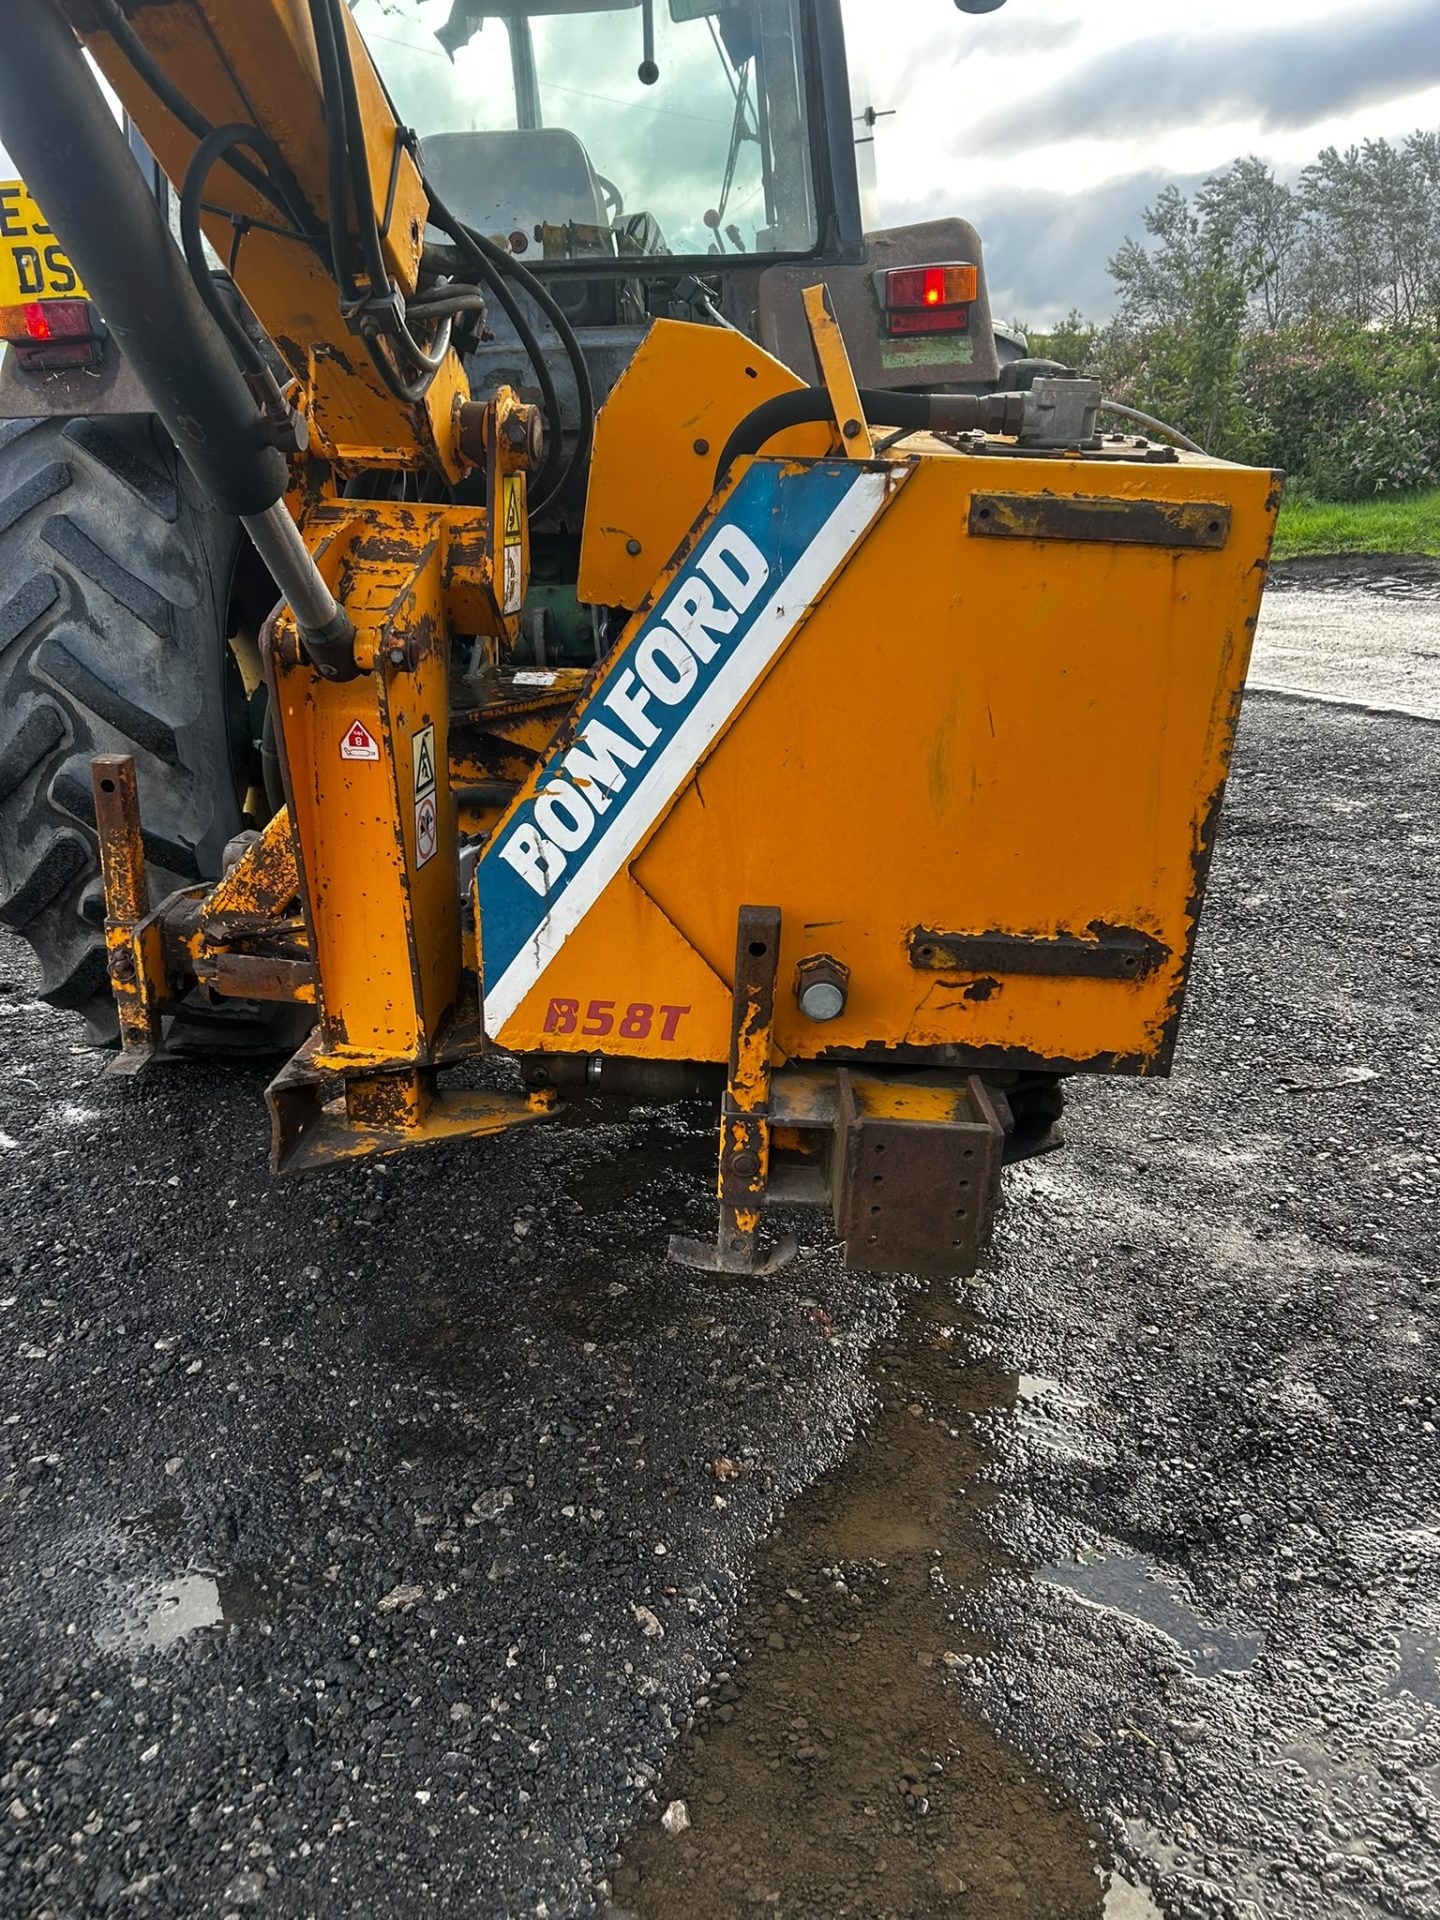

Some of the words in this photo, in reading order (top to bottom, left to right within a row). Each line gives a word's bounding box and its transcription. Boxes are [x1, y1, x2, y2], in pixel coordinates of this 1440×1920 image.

[11, 244, 86, 294] DS
[499, 523, 769, 897] BOMFORD
[542, 997, 692, 1041] B58T
